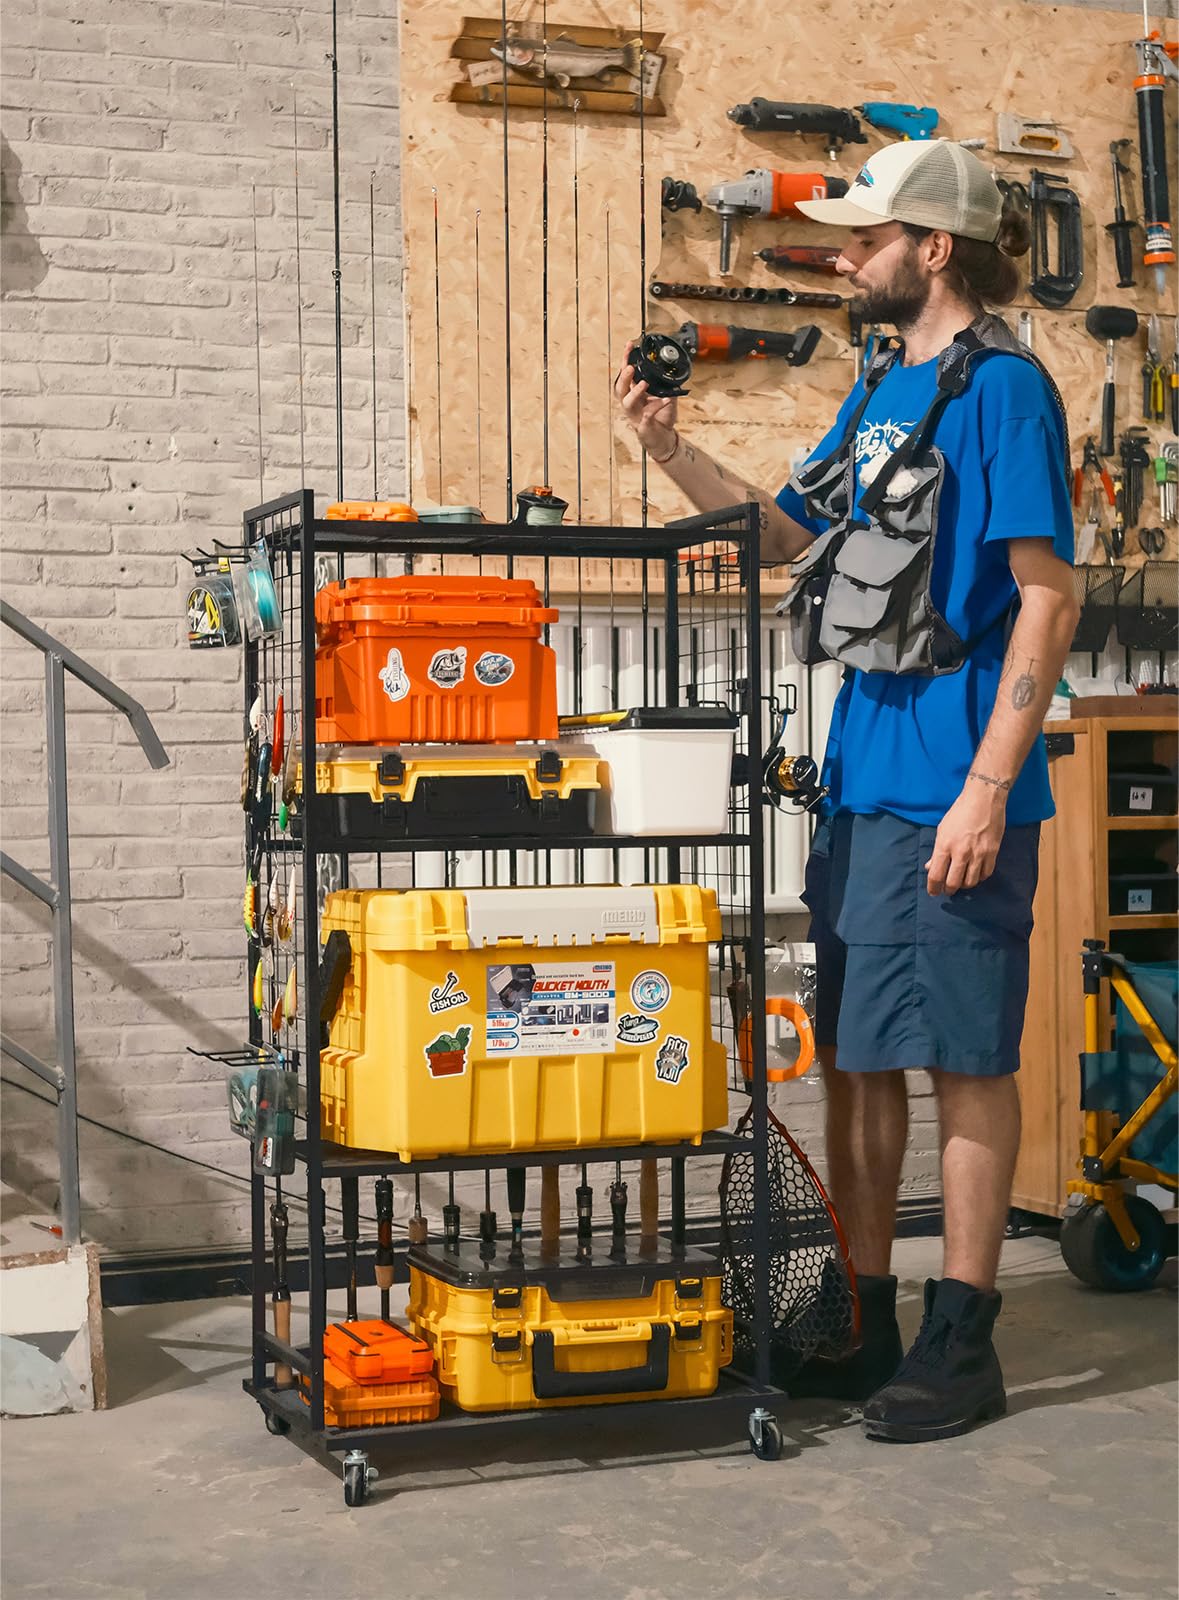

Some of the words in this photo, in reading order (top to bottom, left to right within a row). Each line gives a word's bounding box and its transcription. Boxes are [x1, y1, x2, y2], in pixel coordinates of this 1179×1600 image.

[533, 980, 573, 992] BUCKET
[574, 979, 610, 991] MOUTH
[430, 998, 451, 1012] FISH
[450, 992, 468, 1005] ON.
